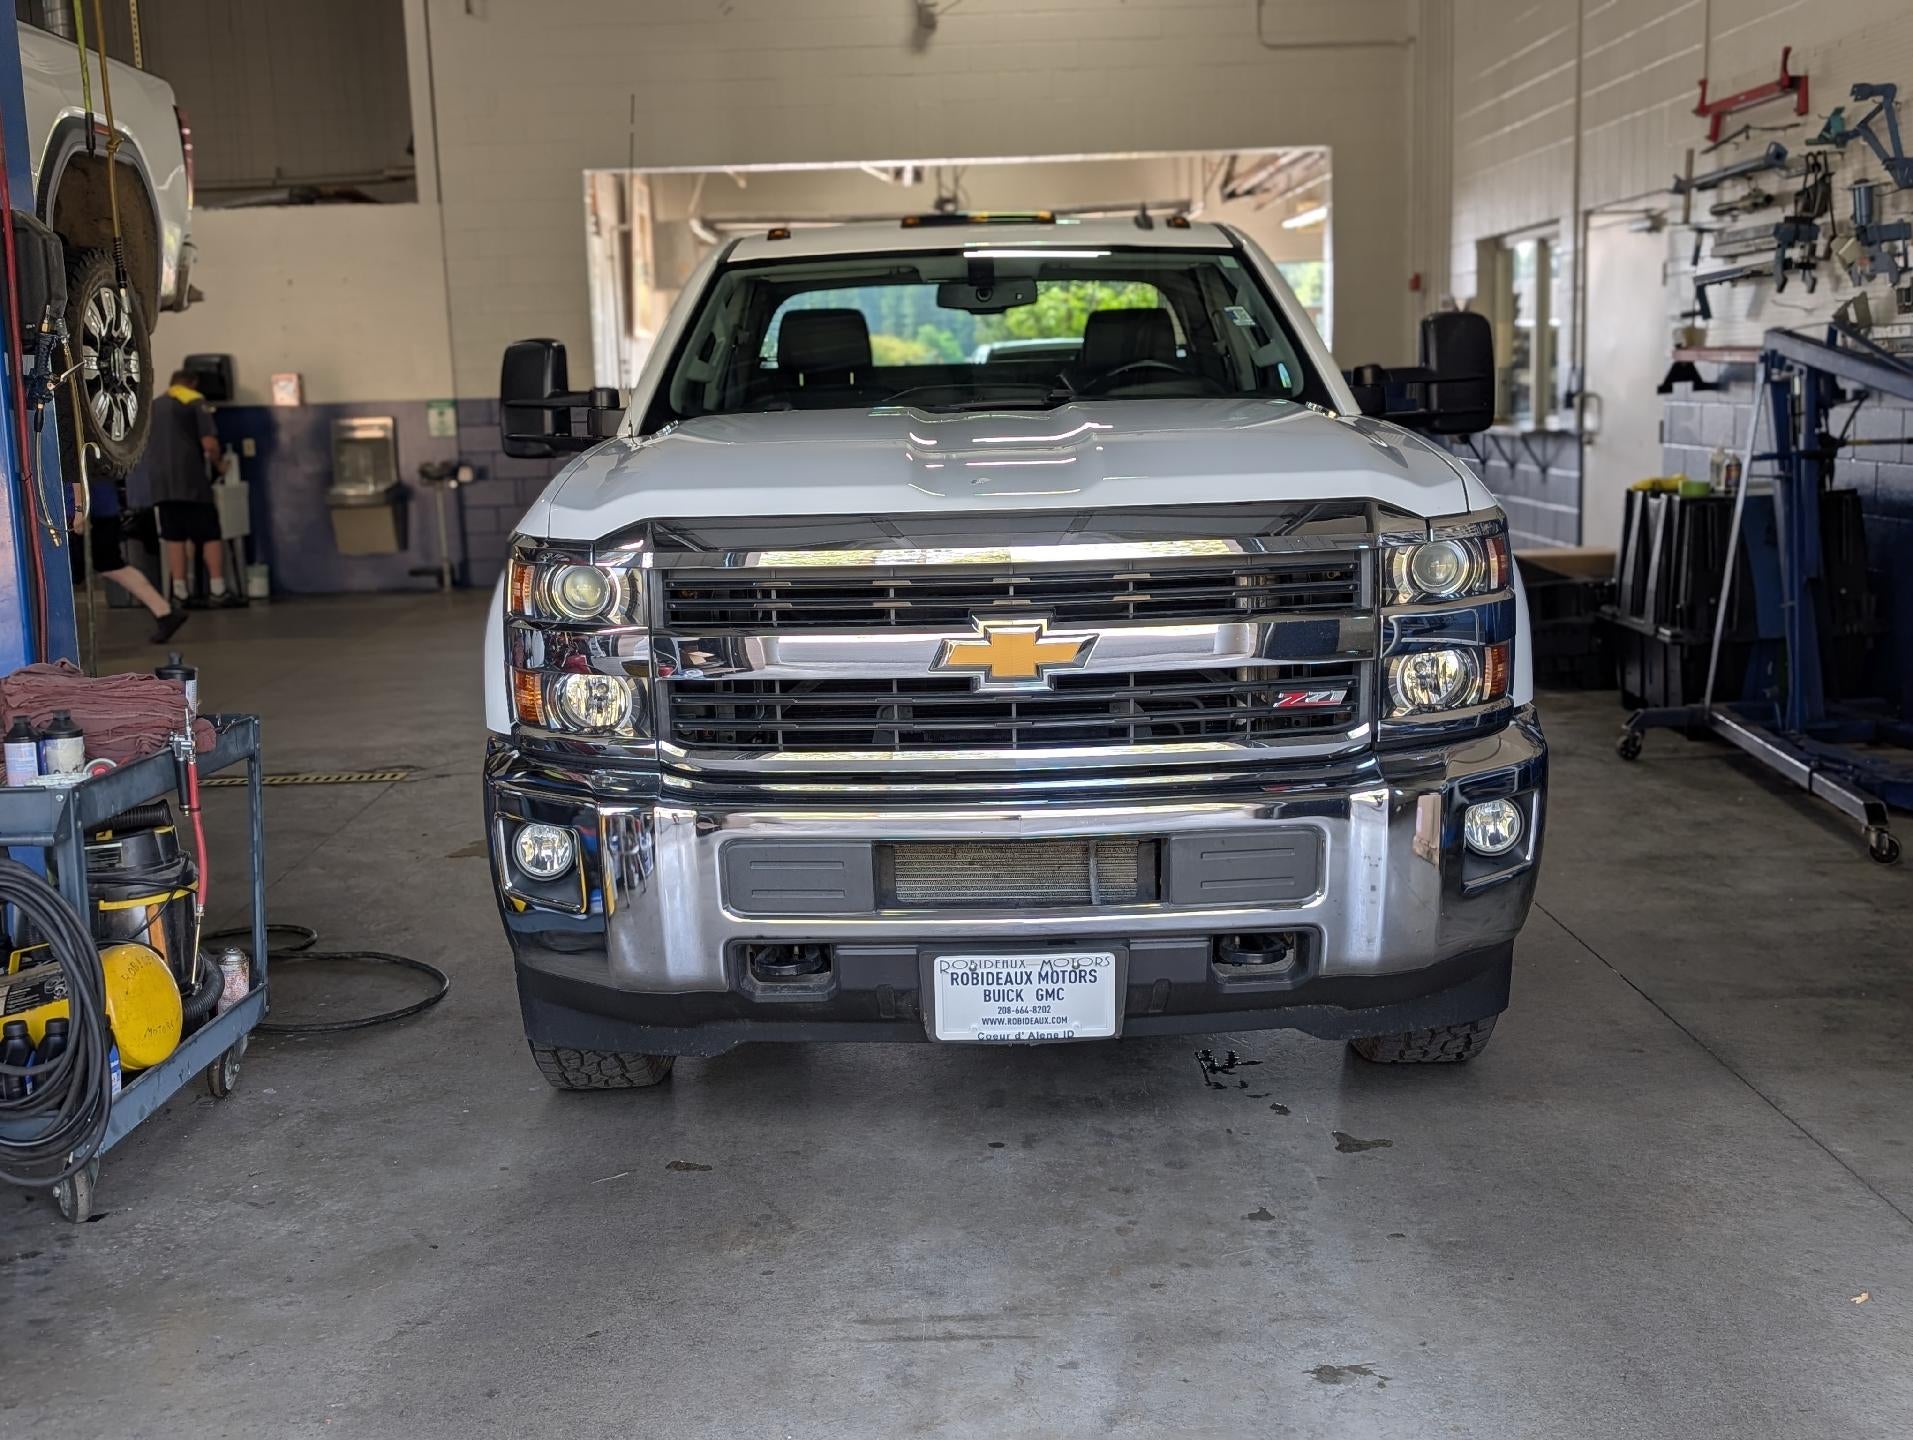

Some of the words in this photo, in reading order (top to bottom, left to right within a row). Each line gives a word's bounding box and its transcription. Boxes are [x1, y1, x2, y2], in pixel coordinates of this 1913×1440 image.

[1273, 689, 1348, 708] Z71
[950, 970, 1033, 986] ROBIDEAUX
[1038, 968, 1098, 985] MOTORS
[983, 988, 1024, 1003] BUICK
[1035, 987, 1065, 1001] GMC
[997, 1005, 1052, 1015] 208-664-8202
[981, 1016, 1068, 1026] WWW.ROBIDEAUX.COM
[977, 1032, 1010, 1041] Coeur
[1028, 1031, 1059, 1040] Alene
[1063, 1030, 1075, 1039] ID
